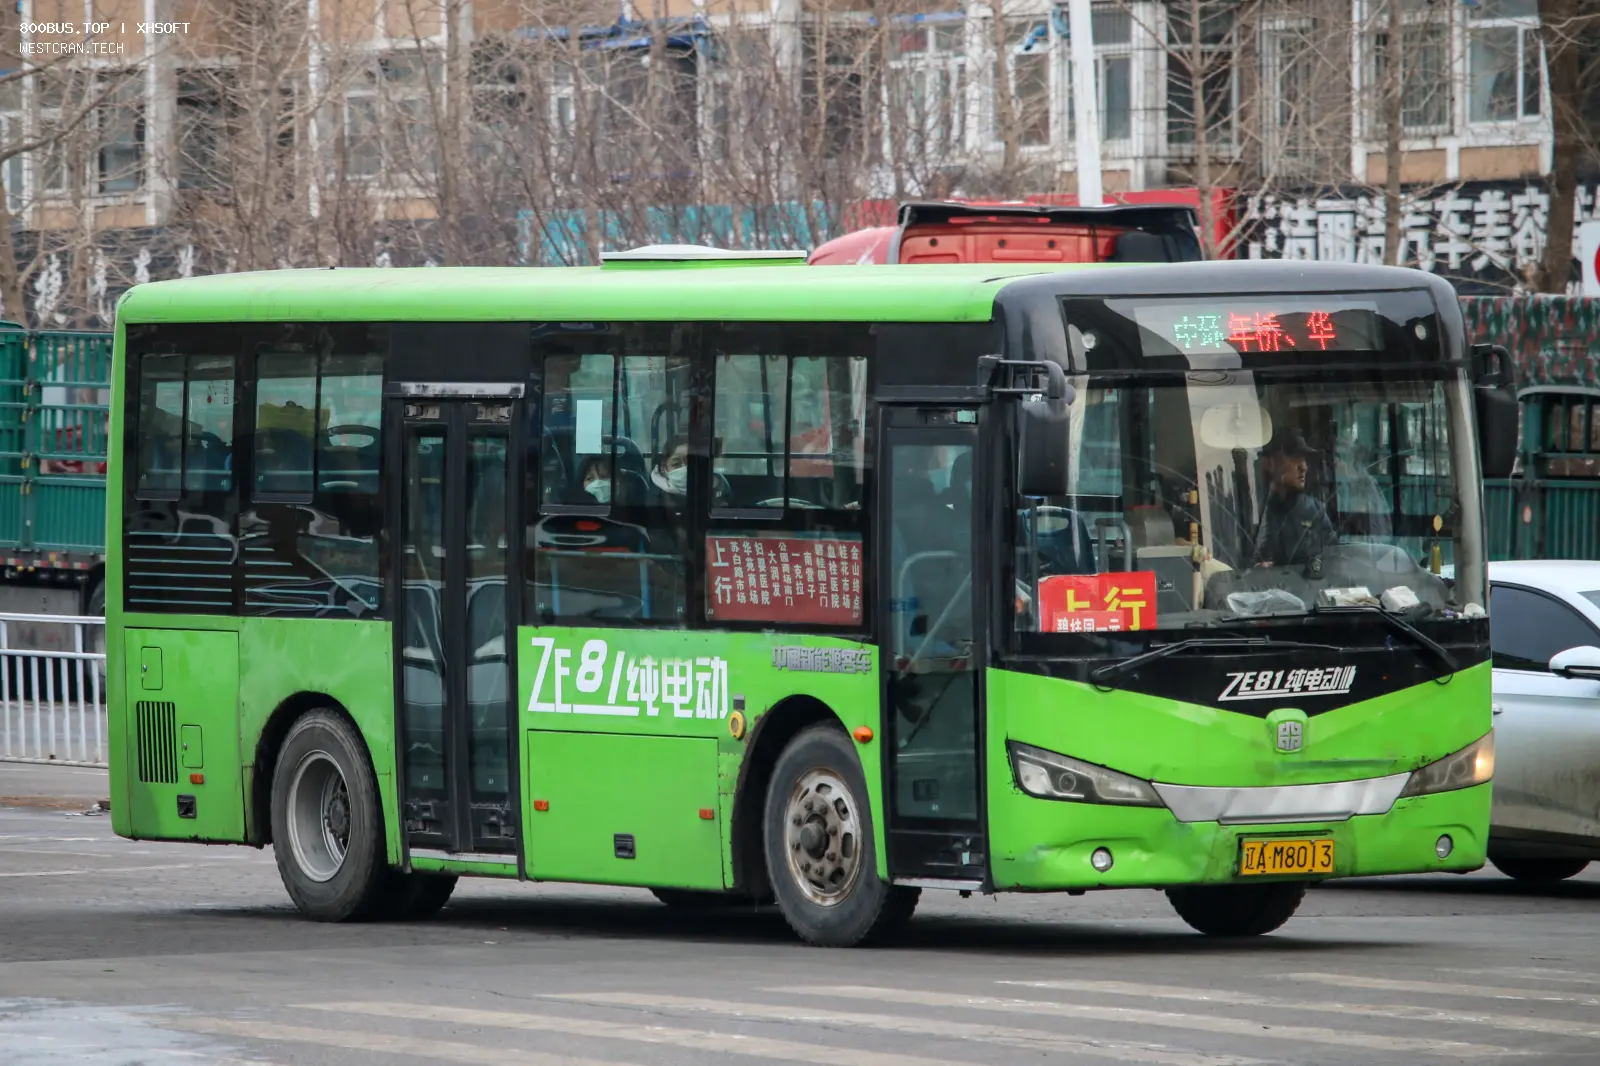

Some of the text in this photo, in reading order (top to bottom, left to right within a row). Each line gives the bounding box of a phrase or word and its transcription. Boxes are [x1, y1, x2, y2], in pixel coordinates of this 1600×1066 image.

[712, 540, 732, 604] 上行
[754, 541, 770, 605] 妇婴医院
[768, 550, 781, 597] 大润发
[791, 552, 804, 595] 一克拉
[803, 551, 816, 599] 南营子
[850, 544, 861, 610] 金山终点
[1066, 586, 1146, 631] 上行
